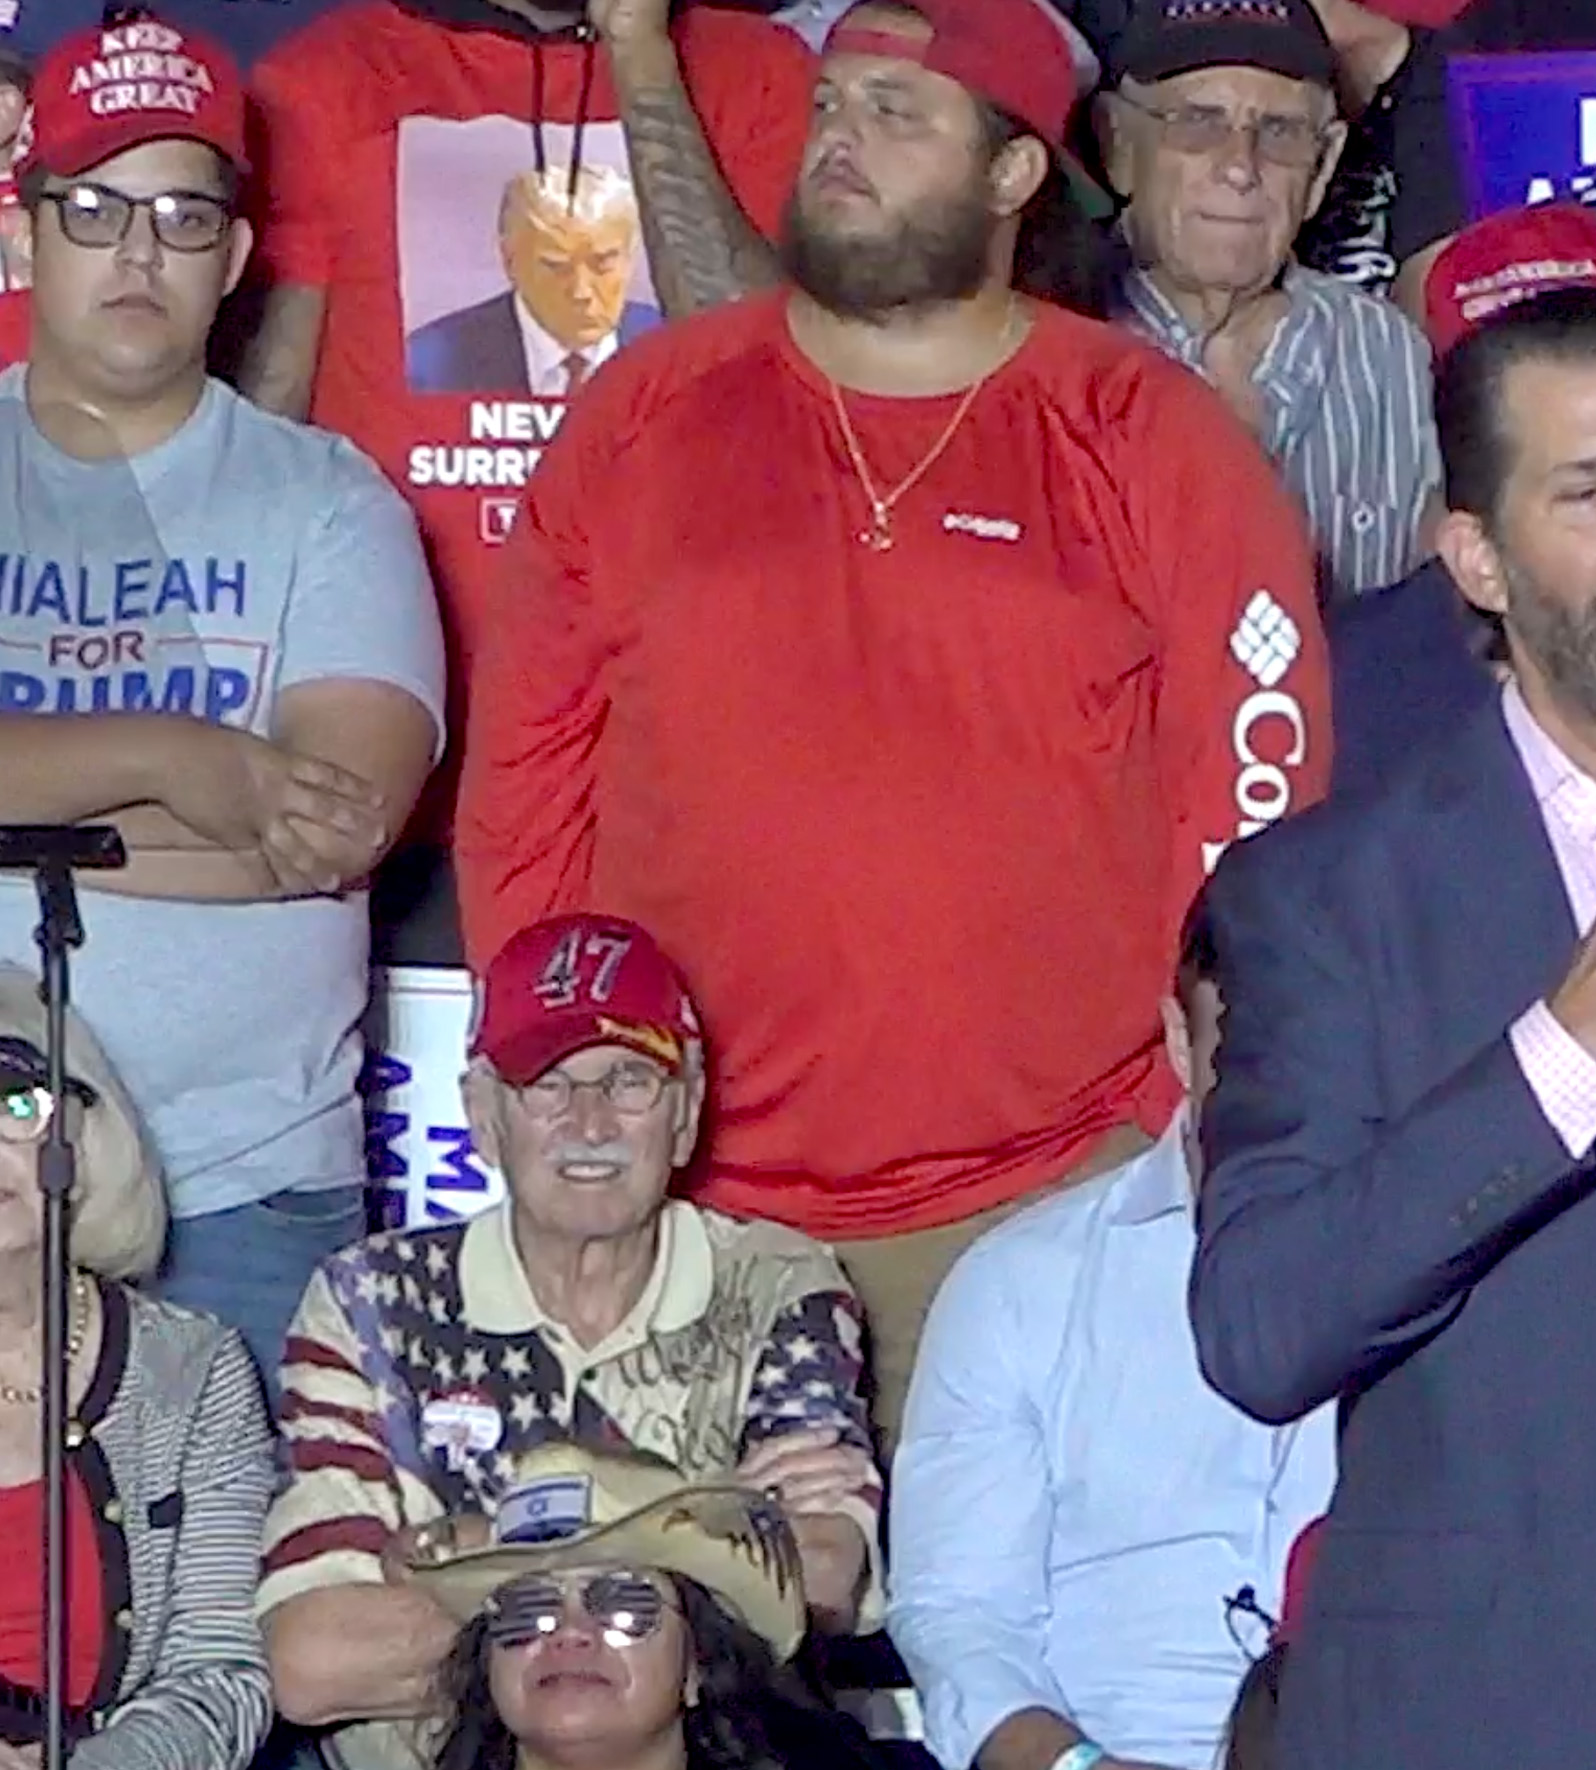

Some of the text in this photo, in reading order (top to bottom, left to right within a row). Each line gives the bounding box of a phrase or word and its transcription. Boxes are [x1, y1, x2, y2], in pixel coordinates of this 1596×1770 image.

[68, 50, 214, 96] AMERICA
[90, 82, 199, 114] GREAT
[48, 630, 146, 670] FOR
[533, 928, 633, 1010] 47
